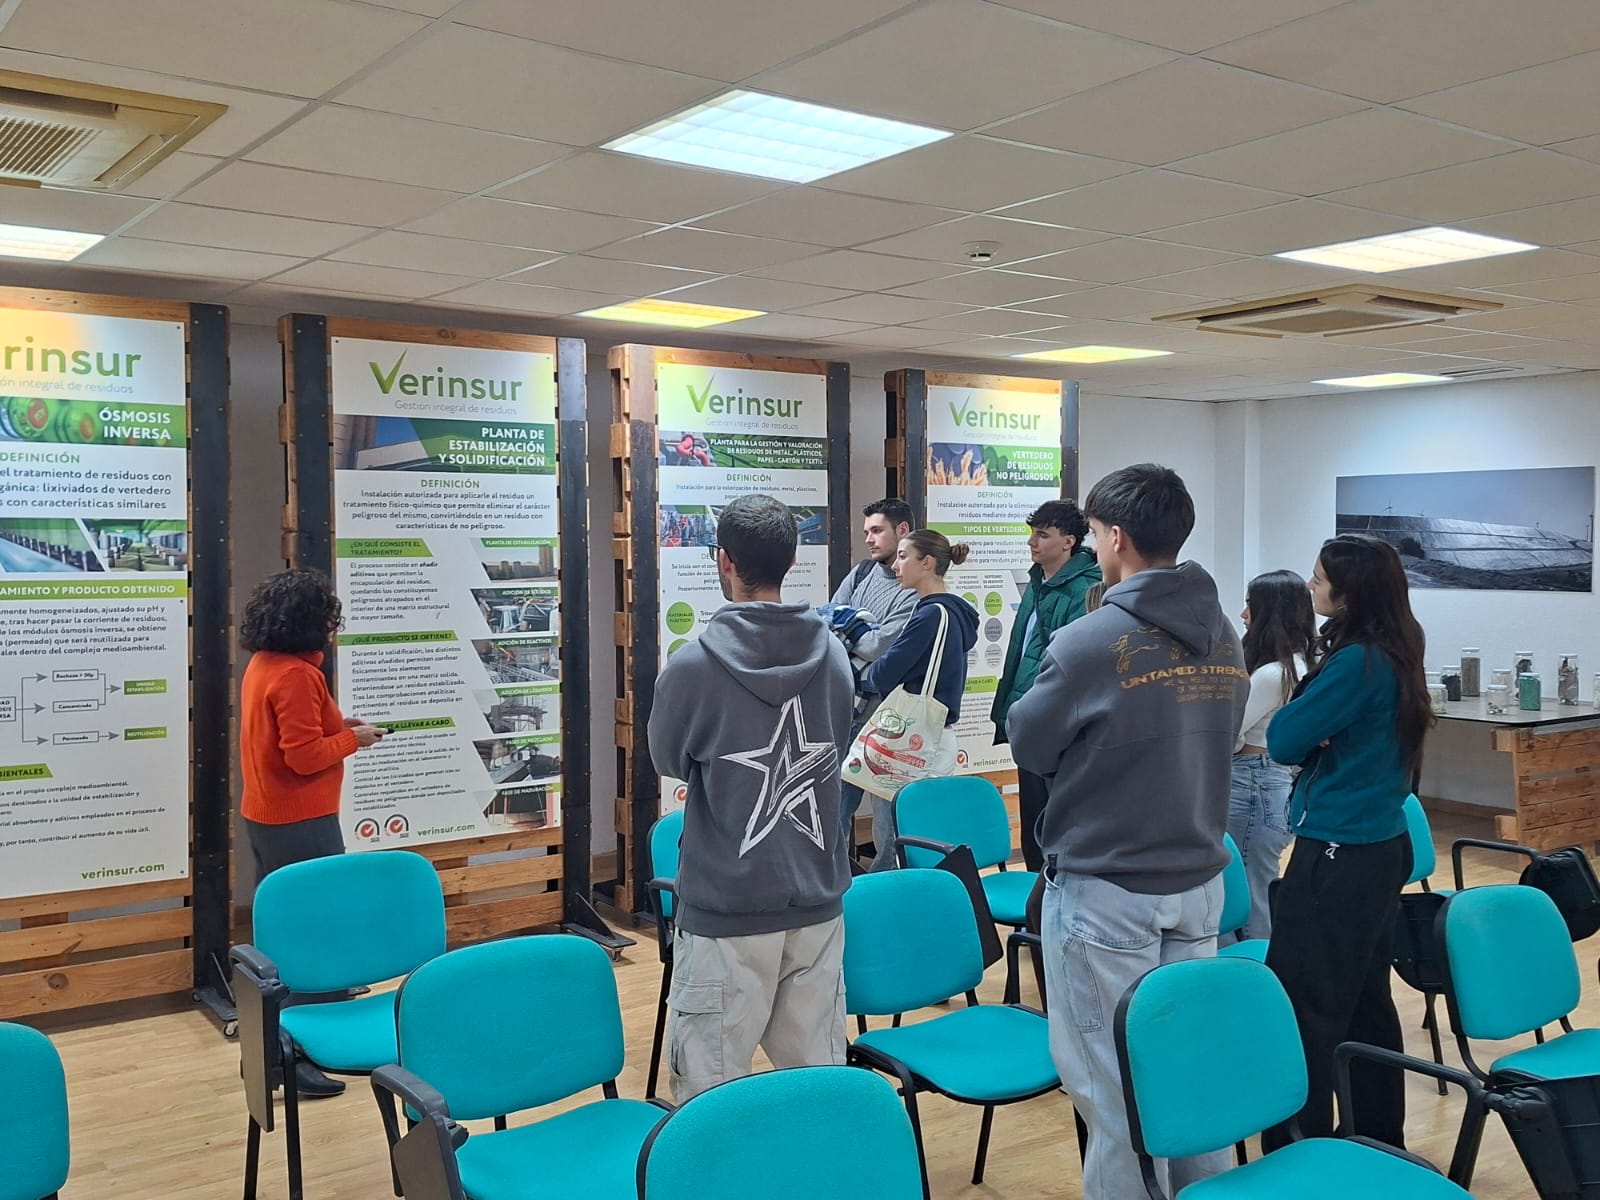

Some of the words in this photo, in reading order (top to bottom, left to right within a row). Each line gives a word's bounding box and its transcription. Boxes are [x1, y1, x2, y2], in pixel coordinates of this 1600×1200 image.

[369, 349, 522, 401] Verinsur
[686, 373, 803, 418] Verinsur
[99, 407, 171, 423] ÓSMOSIS
[949, 393, 1040, 430] Verinsur
[104, 426, 171, 440] INVERSA
[481, 428, 528, 439] PLANTA
[530, 429, 545, 440] DE
[449, 440, 545, 453] ESTABILIZACIÓN
[710, 438, 733, 446] PLANTA
[733, 439, 748, 447] PARA
[749, 439, 757, 447] LA
[757, 440, 783, 448] GESTIÓN
[787, 441, 823, 449] VALORACIÓN
[0, 451, 81, 463] DEFINICIÓN
[765, 448, 773, 456] DE
[773, 449, 793, 457] METAL,
[793, 448, 823, 457] PLÁSTICOS,
[1012, 450, 1054, 460] VERTEDERO
[438, 454, 447, 464] Y
[449, 454, 545, 466] SOLIDIFICACIÓN
[1006, 460, 1017, 469] DE
[1017, 461, 1054, 470] RESIDUOS
[13, 469, 82, 478] tratamiento
[84, 469, 98, 479] de
[101, 470, 149, 480] residuos
[151, 473, 171, 481] con
[726, 473, 772, 482] DEFINICIÓN
[996, 472, 1008, 480] NO
[1009, 471, 1054, 481] PELIGROSOS
[42, 483, 98, 493] lixiviados
[101, 484, 115, 494] de
[118, 486, 171, 495] vertedero
[420, 479, 479, 489] DEFINICIÓN
[361, 490, 402, 498] Instalación
[460, 491, 490, 499] aplicarle
[977, 490, 1013, 499] DEFINICIÓN
[6, 499, 28, 507] con
[31, 499, 114, 508] características
[117, 499, 166, 509] similares
[449, 521, 458, 529] de
[963, 525, 982, 533] TIPOS
[982, 525, 991, 533] DE
[991, 525, 1028, 533] VERTEDERO
[52, 586, 59, 594] Y
[61, 585, 120, 595] PRODUCTO
[121, 585, 175, 594] OBTENIDO
[29, 607, 99, 615] homogeneizados,
[101, 606, 135, 614] ajustado
[146, 605, 158, 613] pH
[26, 617, 49, 625] hacer
[22, 627, 58, 635] módulos
[60, 626, 93, 634] ósmosis
[136, 624, 166, 632] obtiene
[4, 638, 52, 647] (permeado)
[89, 635, 131, 643] reutilizada
[48, 647, 61, 655] del
[63, 646, 101, 655] complejo
[1120, 665, 1197, 689] UNTAMED
[417, 824, 475, 837] verinsur.com
[81, 864, 165, 879] verinsur.com
